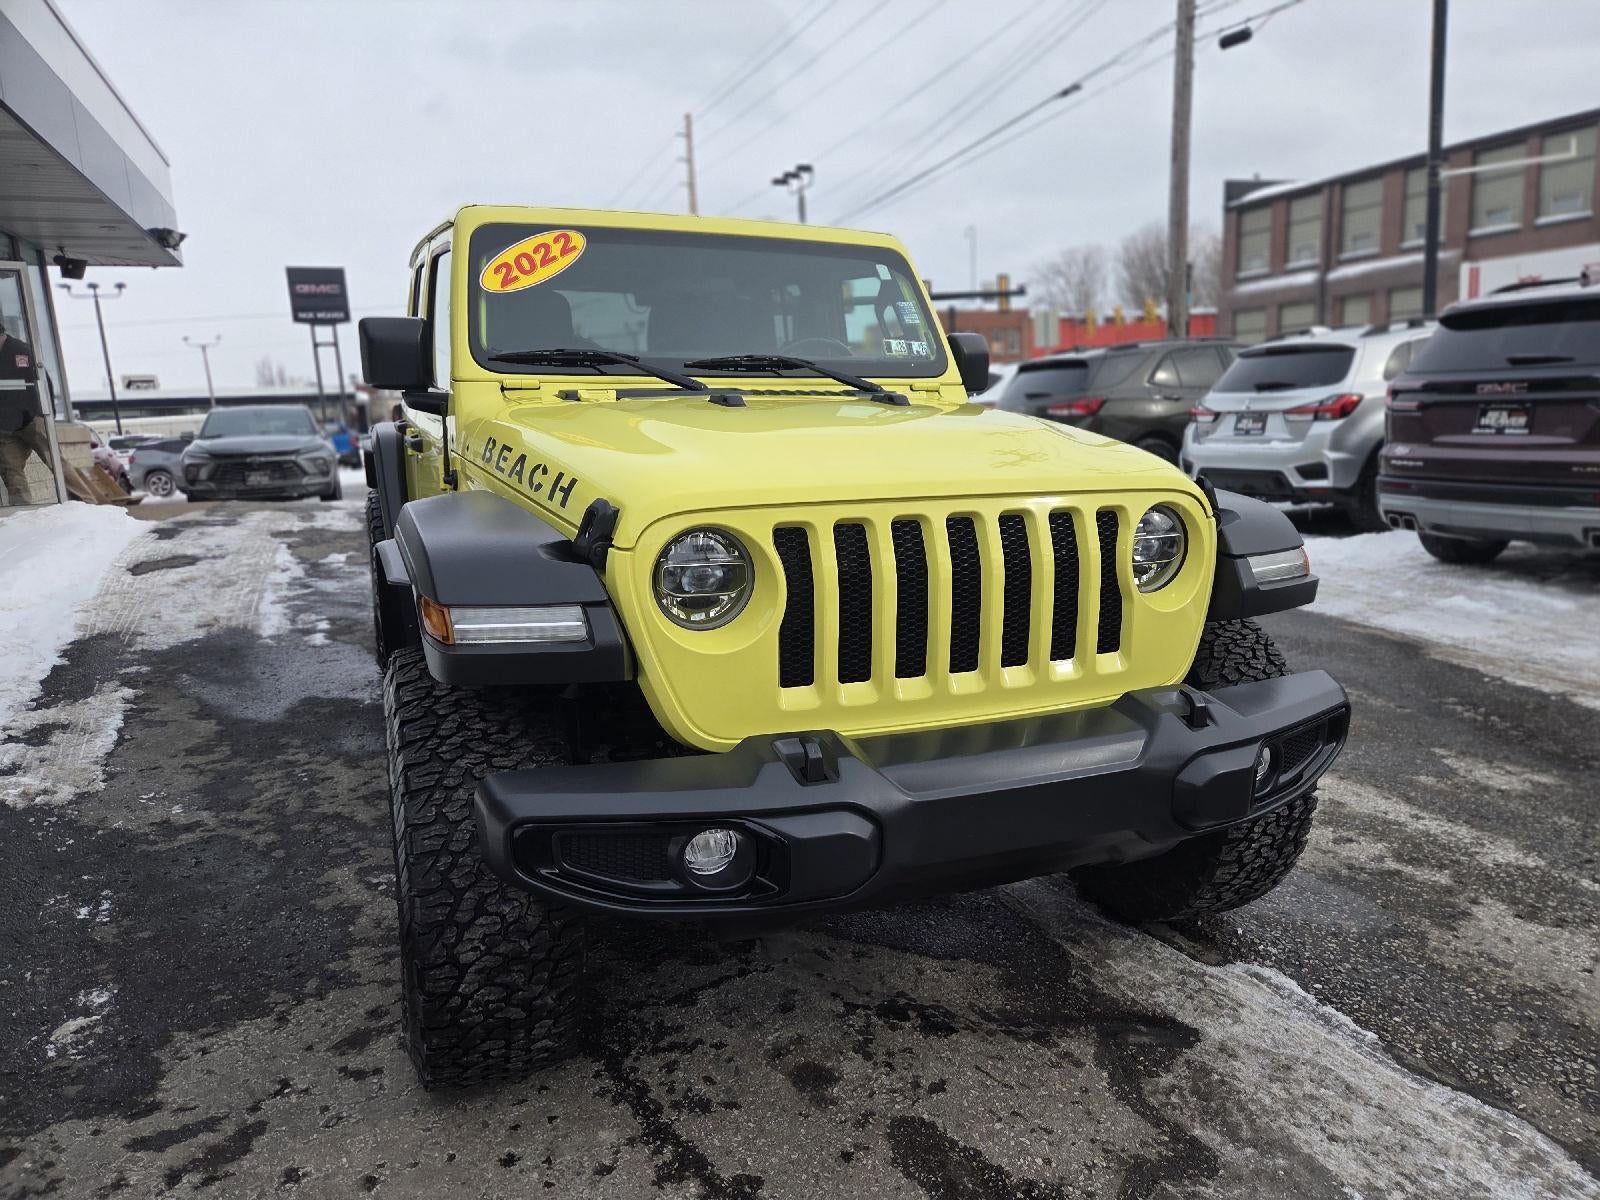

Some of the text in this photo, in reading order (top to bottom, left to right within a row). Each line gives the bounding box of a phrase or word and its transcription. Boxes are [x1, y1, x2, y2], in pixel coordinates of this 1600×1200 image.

[493, 232, 578, 289] 2022
[295, 284, 341, 294] GMC
[1476, 383, 1528, 394] GMC
[482, 436, 578, 508] BEACH
